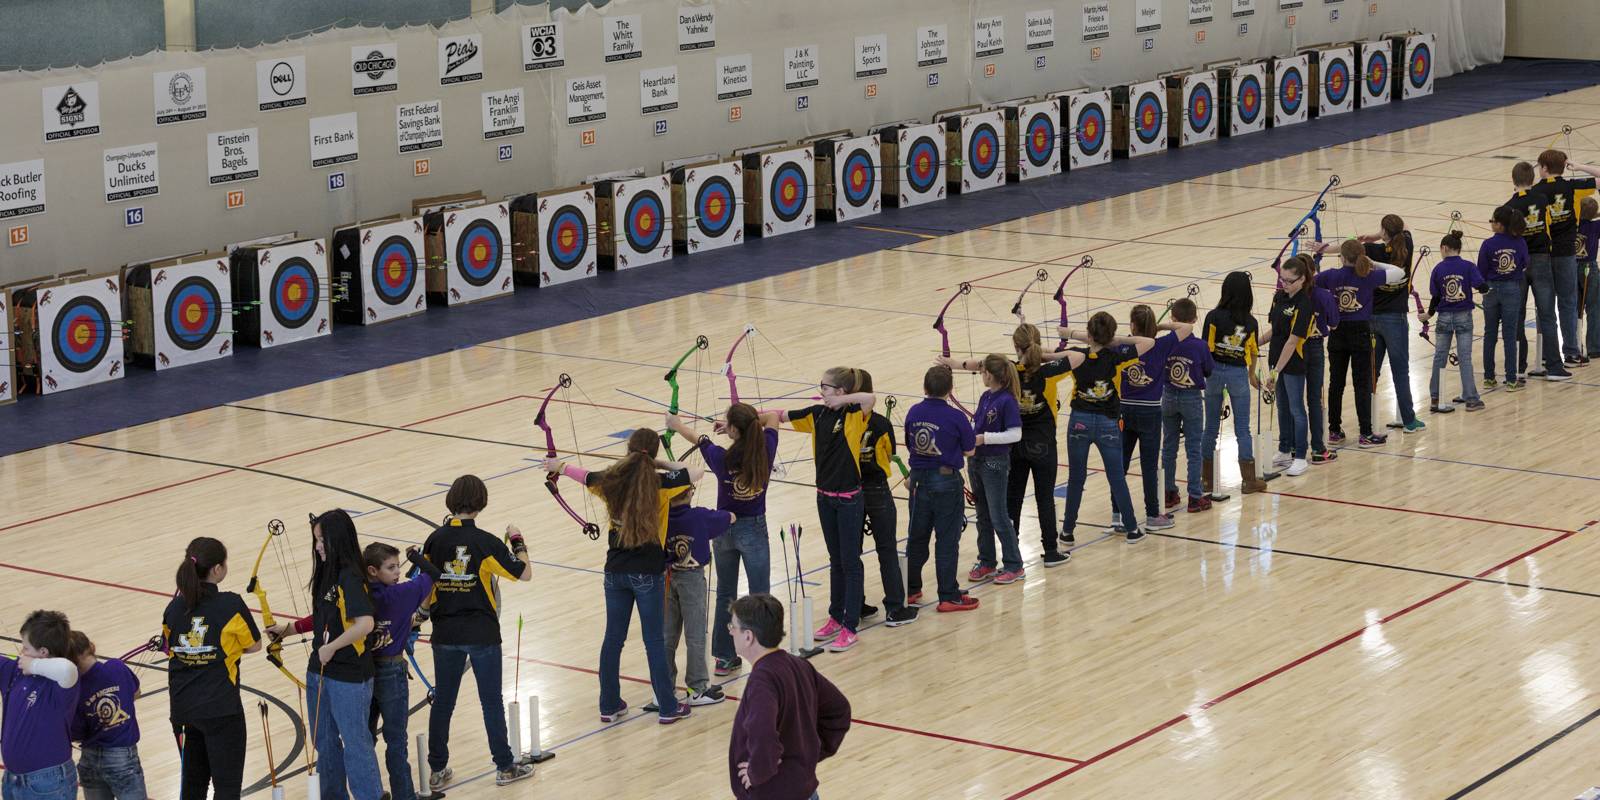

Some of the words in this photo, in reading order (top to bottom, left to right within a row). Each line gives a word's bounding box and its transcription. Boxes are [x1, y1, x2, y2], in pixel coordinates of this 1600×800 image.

[1141, 8, 1156, 17] Meijer
[679, 15, 692, 25] Dan
[696, 12, 714, 24] Wendy
[616, 20, 630, 30] The
[686, 24, 709, 35] Yahnke
[977, 22, 991, 31] Mary
[991, 19, 1002, 27] Ann
[1084, 24, 1108, 33] Associates
[531, 26, 556, 37] WCIA
[613, 30, 633, 41] Whitt
[928, 30, 938, 38] The
[612, 41, 634, 52] Family
[862, 43, 881, 54] Jerry's
[977, 40, 989, 49] Paul
[989, 38, 1002, 47] Keith
[804, 48, 809, 57] K
[924, 49, 942, 58] Family
[355, 62, 368, 72] OLD
[367, 60, 396, 71] CHICAGO
[862, 55, 881, 67] Sports
[1037, 58, 1045, 67] 28
[723, 64, 746, 74] Human
[796, 69, 809, 79] LLC
[986, 66, 995, 75] 27
[273, 74, 292, 84] DELL
[643, 74, 676, 88] Heartland
[723, 74, 748, 86] Kinetics
[929, 74, 938, 84] 26
[572, 82, 585, 91] Geis
[586, 80, 602, 90] Asset
[867, 86, 876, 96] 25
[569, 91, 605, 104] Management,
[652, 88, 668, 98] Bank
[261, 102, 282, 110] OFFICIAL
[283, 99, 305, 107] SPONSOR
[488, 96, 502, 106] The
[503, 93, 520, 105] Angi
[798, 98, 808, 108] 24
[400, 107, 415, 117] First
[416, 102, 439, 115] Federal
[490, 106, 518, 116] Franklin
[731, 108, 741, 119] 23
[61, 114, 83, 123] SIGNS
[158, 115, 180, 123] OFFICIAL
[182, 112, 205, 121] SPONSOR
[399, 118, 424, 130] Savings
[424, 115, 441, 126] Bank
[493, 116, 517, 127] Family
[656, 121, 667, 133] 22
[47, 131, 71, 140] OFFICIAL
[73, 126, 98, 136] SPONSOR
[314, 135, 332, 146] First
[334, 130, 354, 143] Bank
[584, 133, 594, 144] 21
[218, 133, 250, 146] Einstein
[224, 146, 245, 157] Bros.
[500, 148, 511, 158] 20
[222, 156, 248, 170] Bagels
[314, 159, 334, 167] OFFICIAL
[336, 154, 357, 163] SPONSOR
[118, 160, 146, 173] Ducks
[416, 161, 428, 173] 19
[13, 172, 42, 185] Butler
[109, 171, 155, 188] Unlimited
[212, 175, 233, 183] OFFICIAL
[235, 171, 258, 180] SPONSOR
[331, 175, 343, 187] 18
[108, 191, 131, 200] OFFICIAL
[133, 187, 158, 197] SPONSOR
[230, 194, 242, 205] 17
[18, 206, 43, 215] SPONSOR
[128, 210, 142, 223] 16
[13, 229, 26, 242] 15
